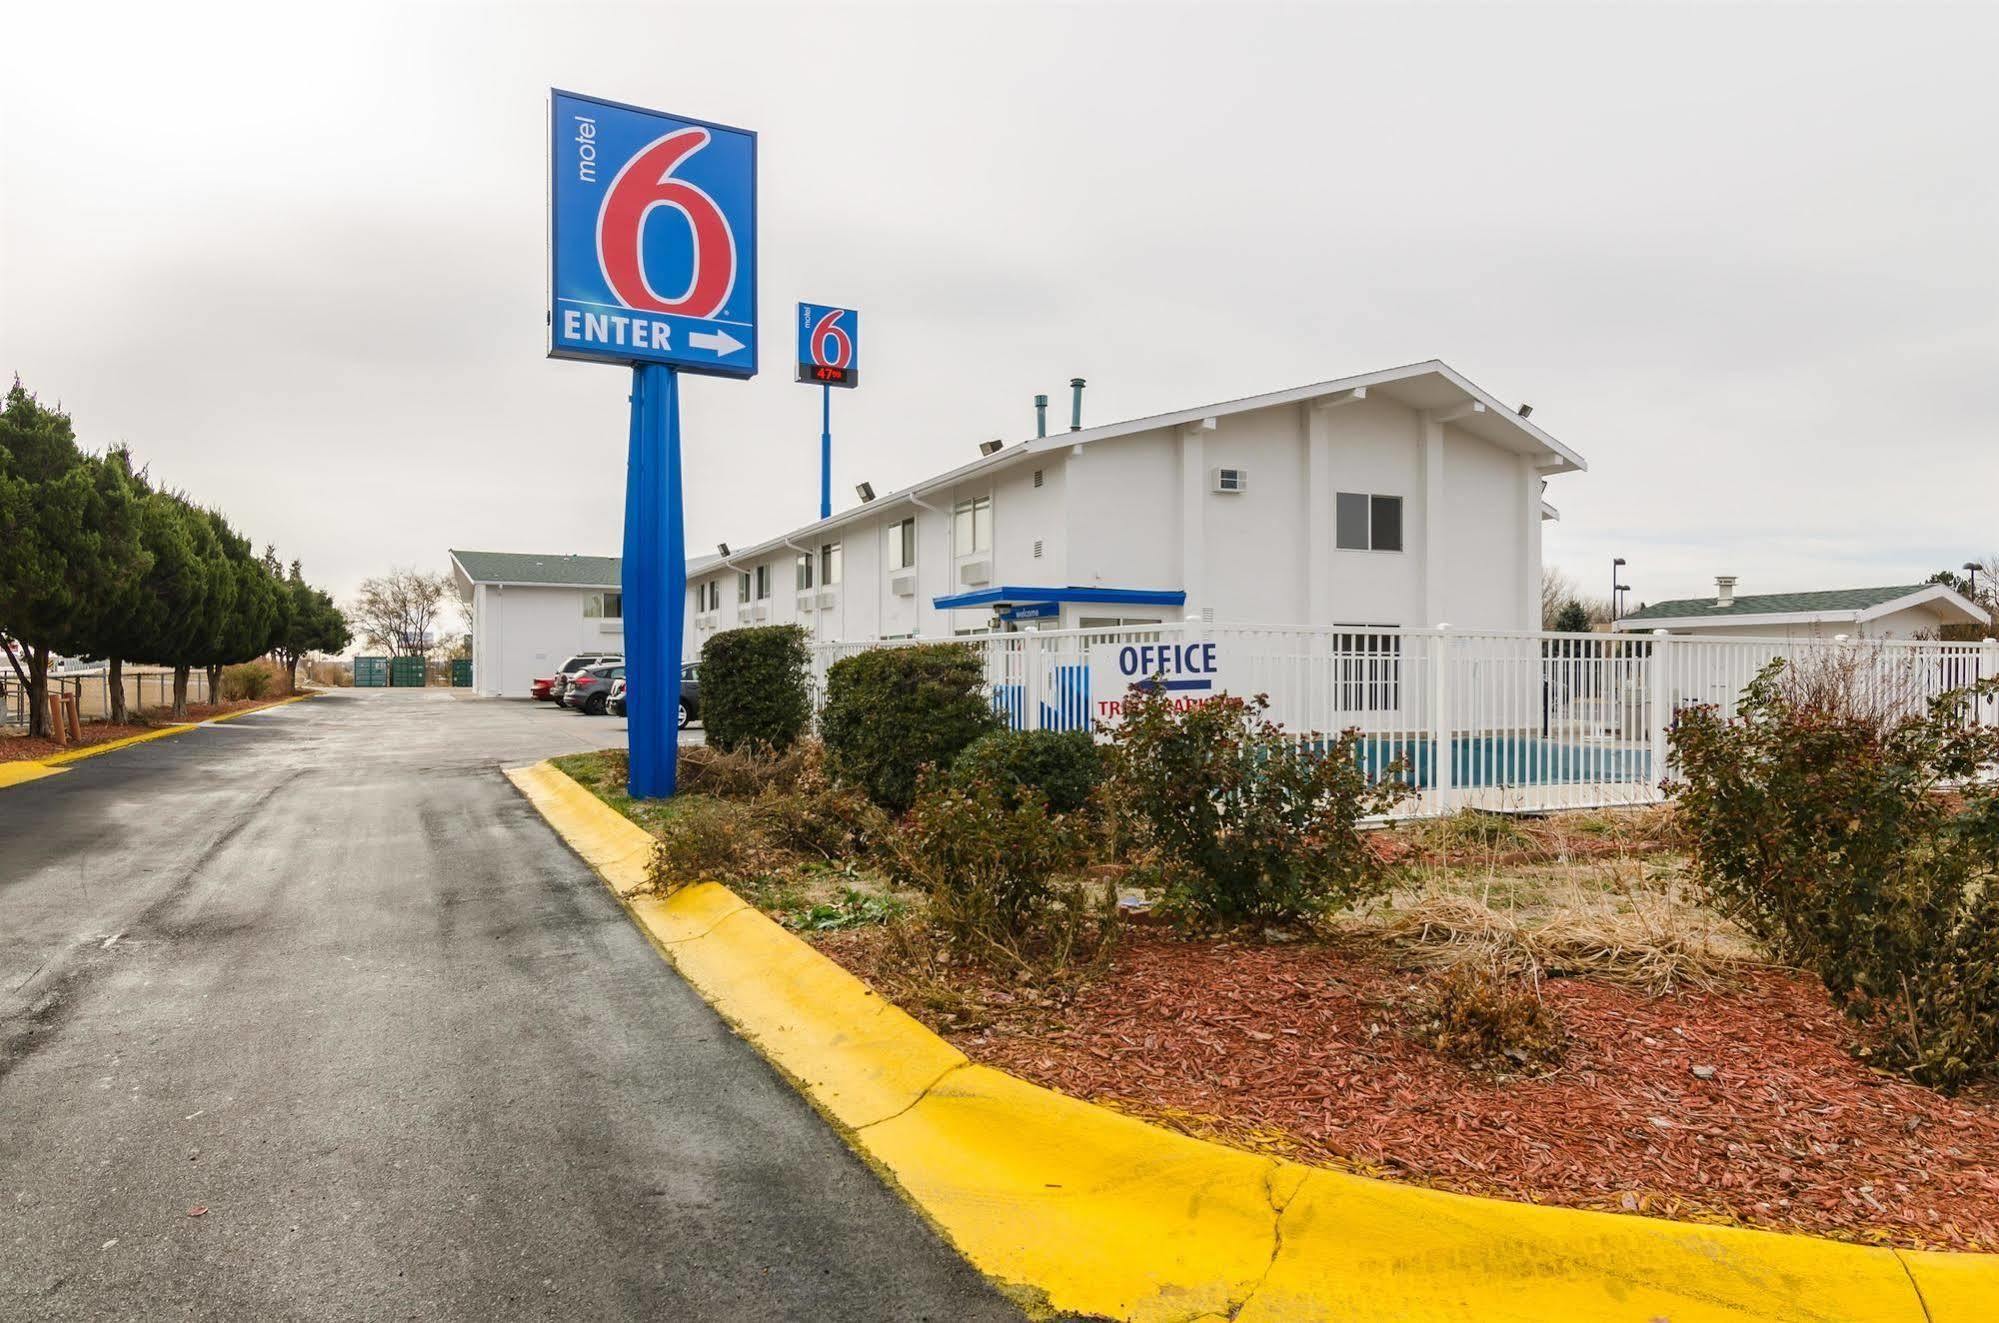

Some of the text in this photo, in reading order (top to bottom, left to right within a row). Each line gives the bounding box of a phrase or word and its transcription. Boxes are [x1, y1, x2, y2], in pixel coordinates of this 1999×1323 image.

[575, 116, 595, 182] motel
[596, 126, 737, 320] 6
[564, 310, 671, 351] ENTER
[810, 310, 852, 368] 6
[1119, 644, 1217, 675] OFFICE
